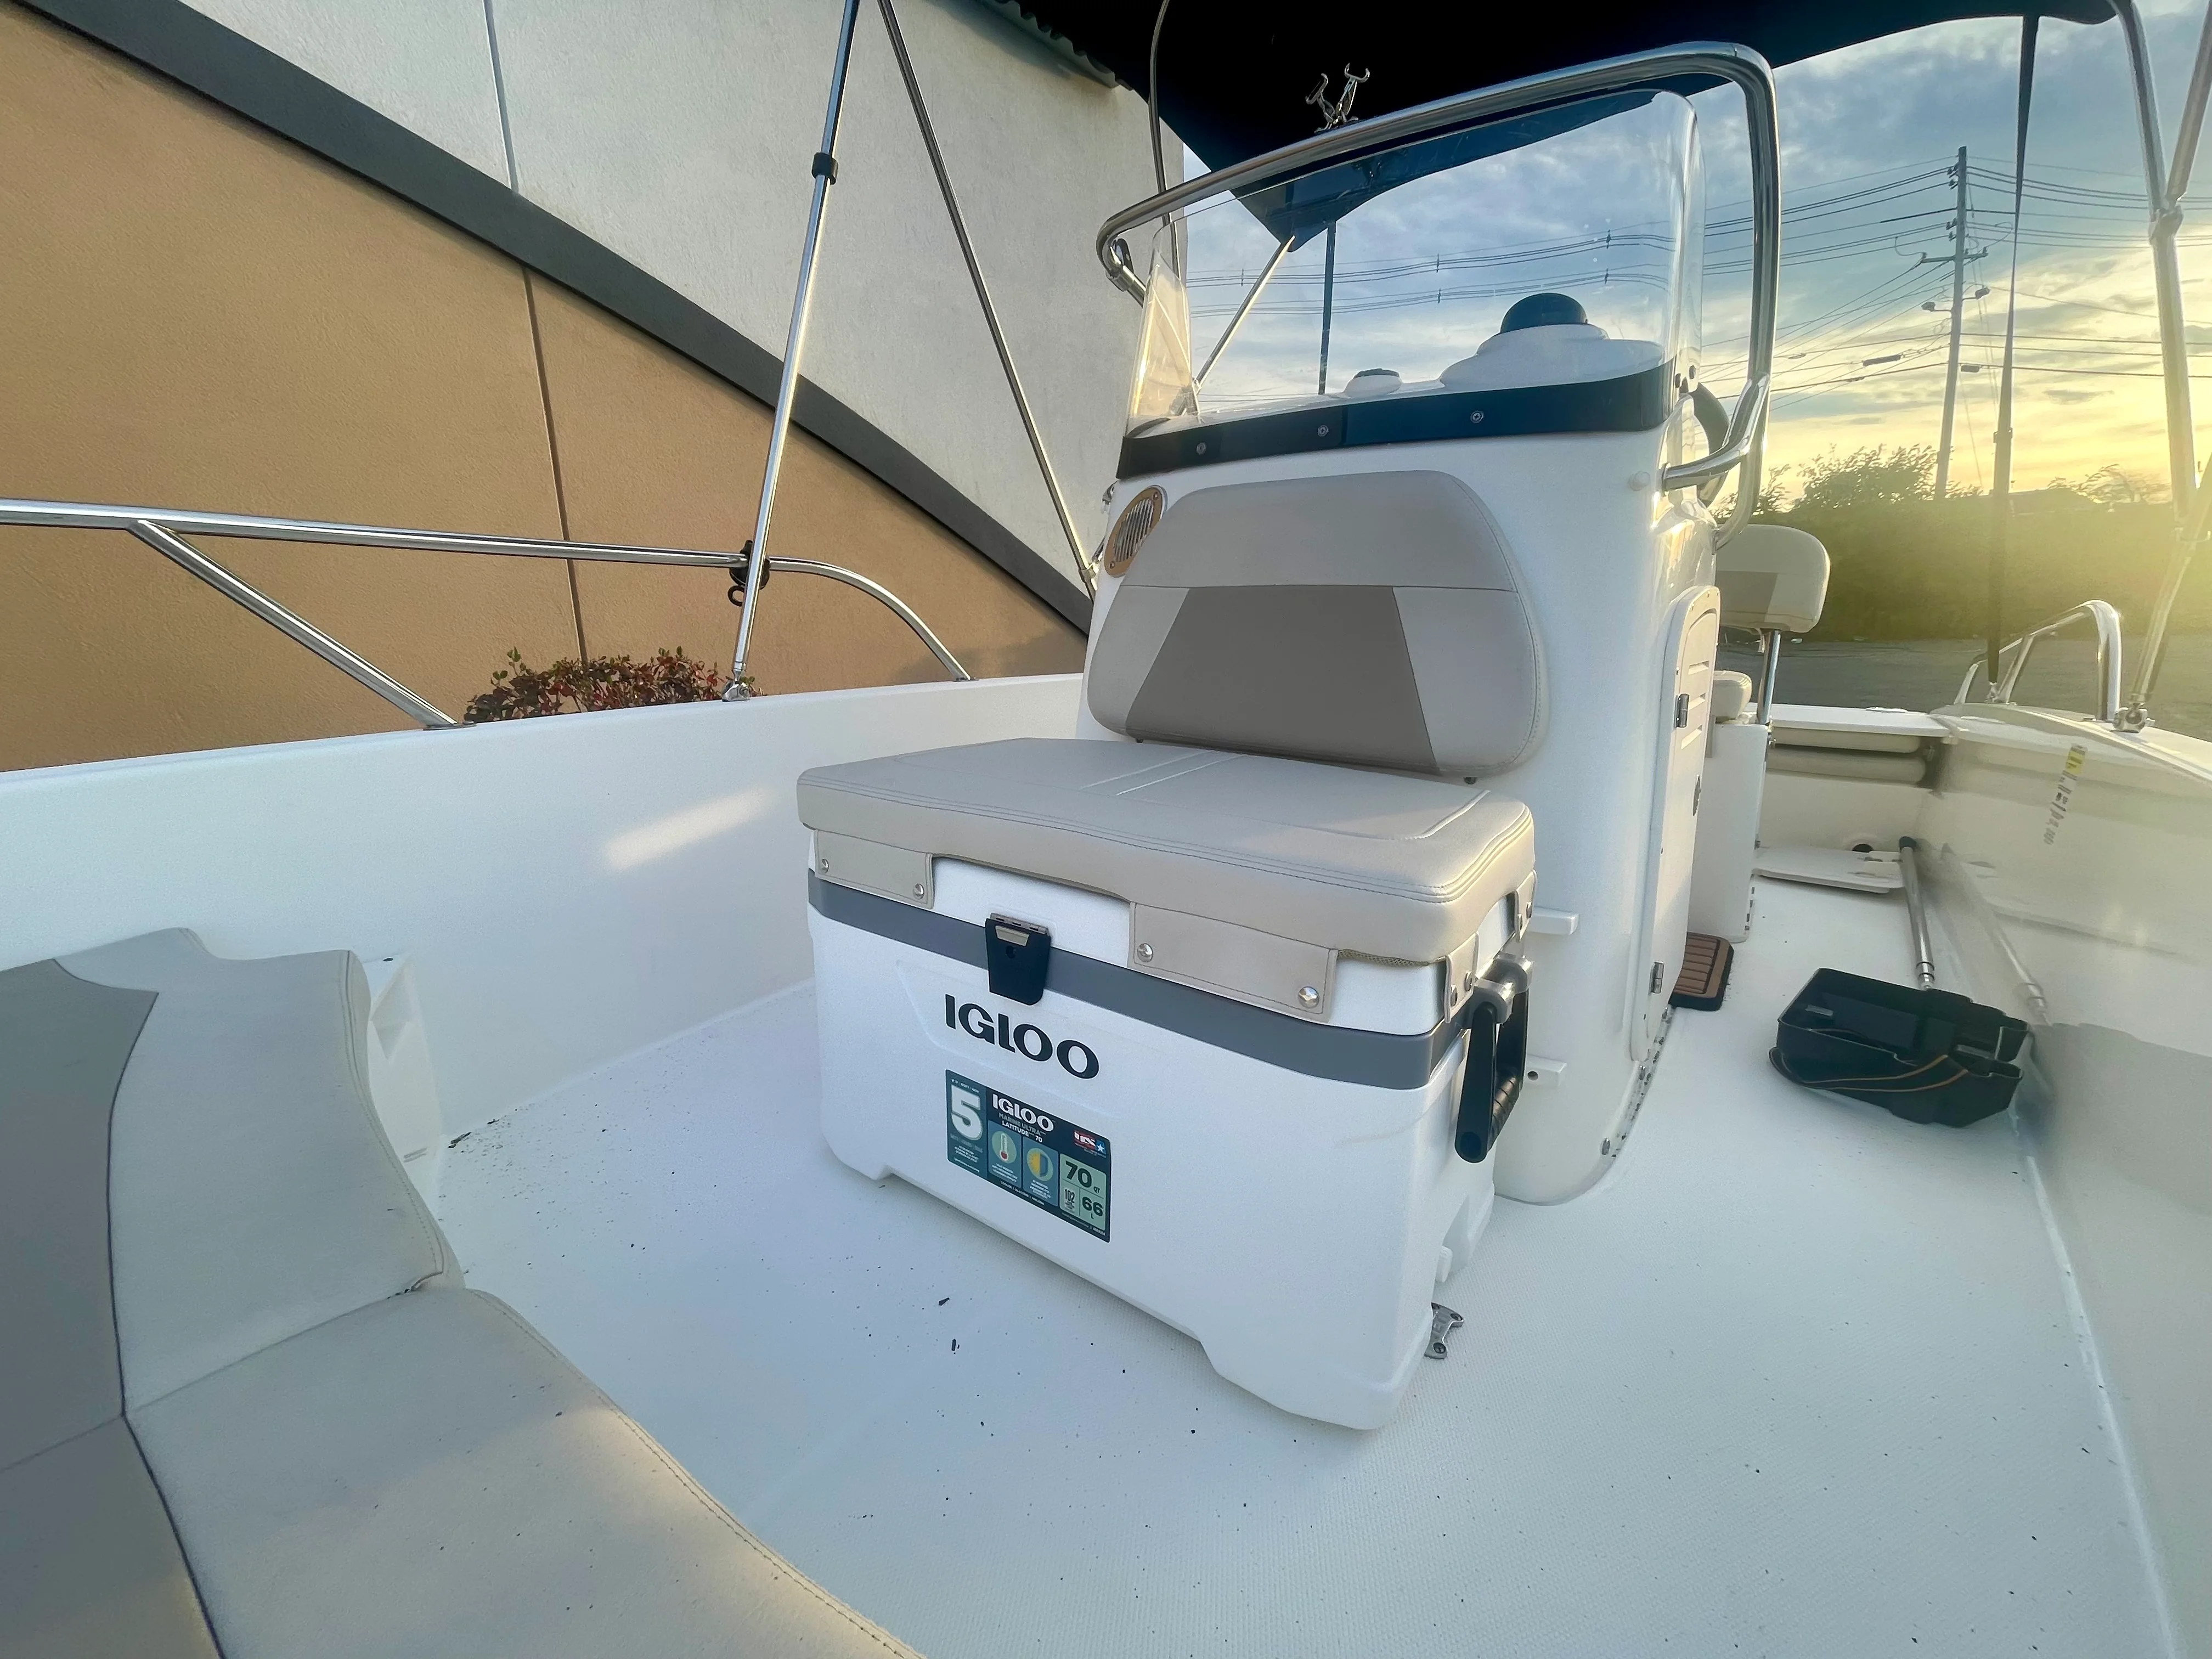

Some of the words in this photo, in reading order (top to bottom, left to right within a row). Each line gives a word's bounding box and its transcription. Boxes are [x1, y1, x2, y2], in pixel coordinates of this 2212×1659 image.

[945, 994, 1099, 1079] IGLOO
[951, 1084, 983, 1141] 5
[992, 1093, 1054, 1132] IGLOO
[1002, 1120, 1030, 1137] LATITUDE
[1035, 1135, 1043, 1143] 70
[1065, 1160, 1092, 1188] 70
[1064, 1188, 1075, 1204] 102
[1082, 1197, 1104, 1217] 66
